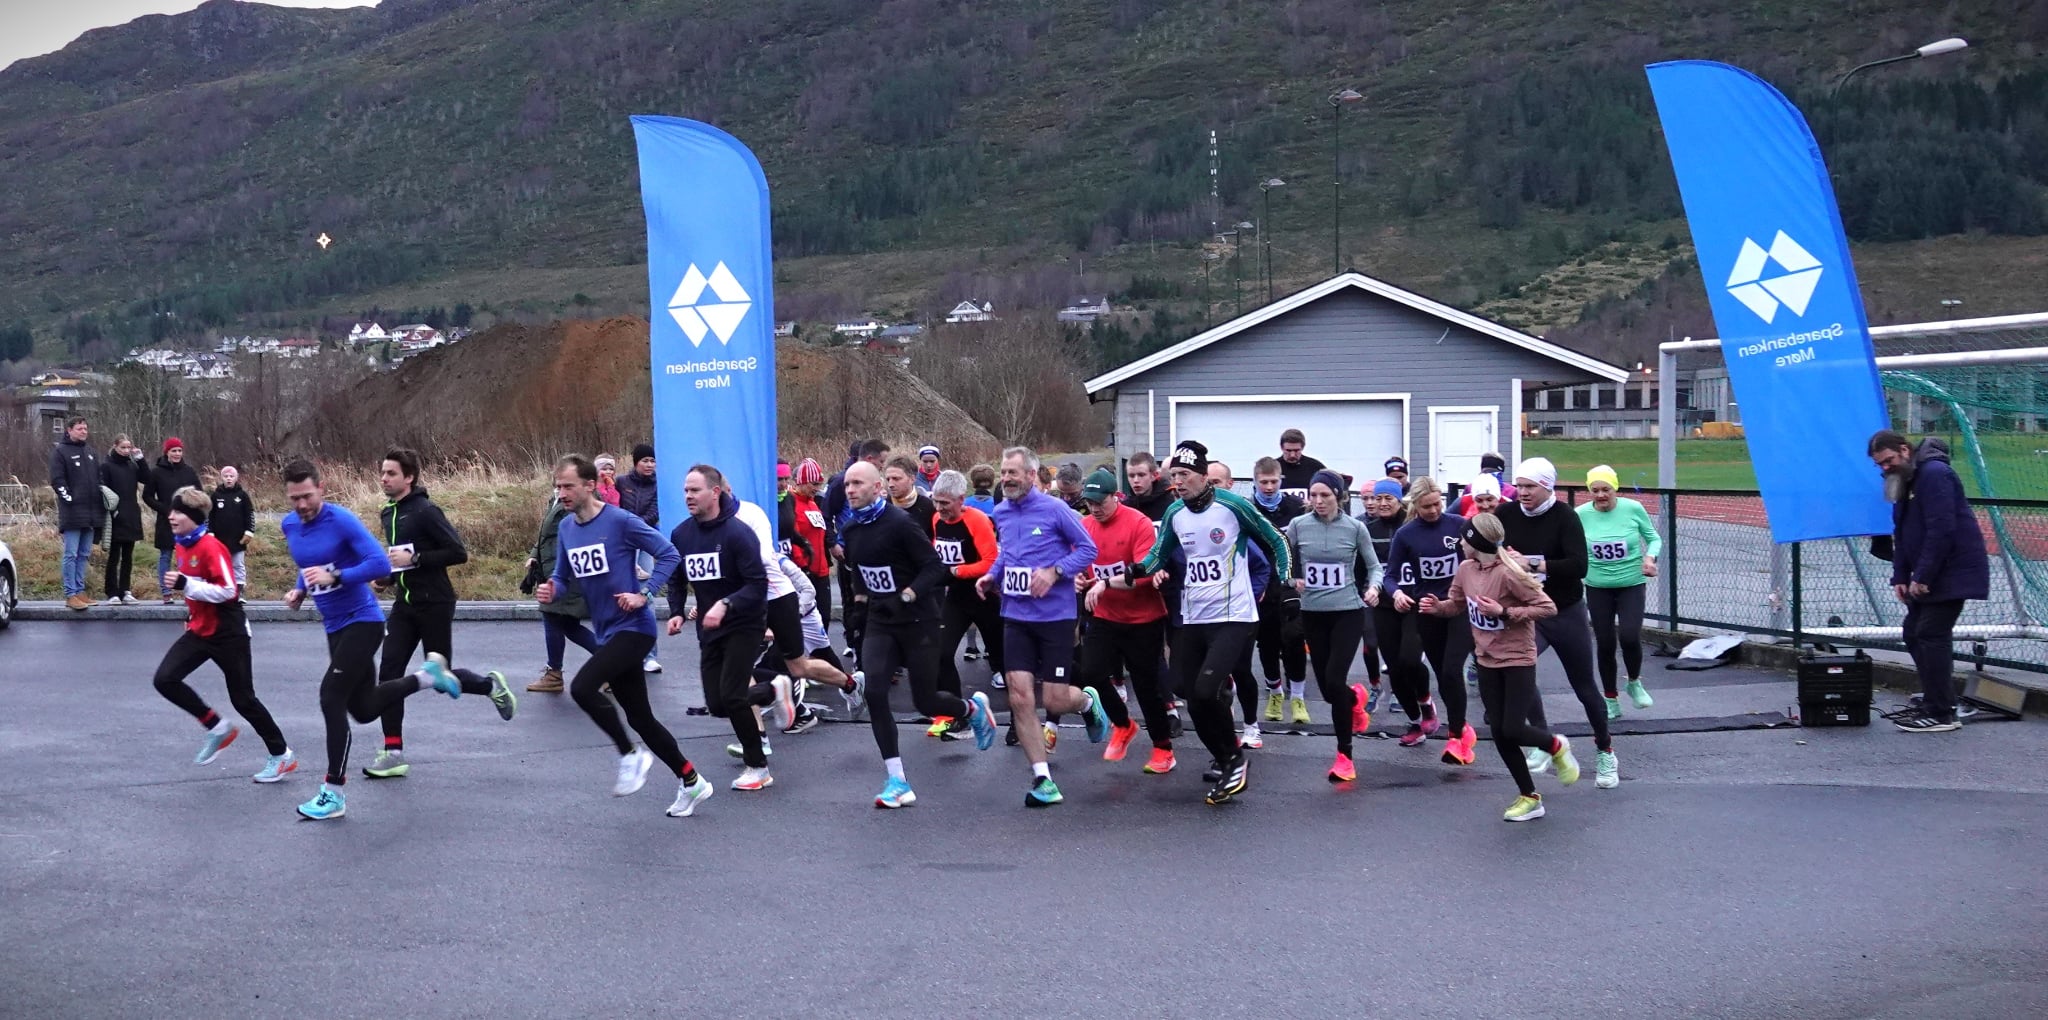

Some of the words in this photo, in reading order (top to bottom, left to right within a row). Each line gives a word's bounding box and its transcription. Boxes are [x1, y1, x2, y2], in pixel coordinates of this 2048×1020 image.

[571, 549, 602, 574] 326
[936, 545, 960, 564] 312
[1593, 543, 1625, 560] 335
[687, 557, 716, 580] 334
[1187, 560, 1219, 583] 303
[1308, 567, 1340, 585] 311
[1420, 557, 1454, 578] 327
[862, 569, 892, 590] 338
[1005, 571, 1027, 592] 320
